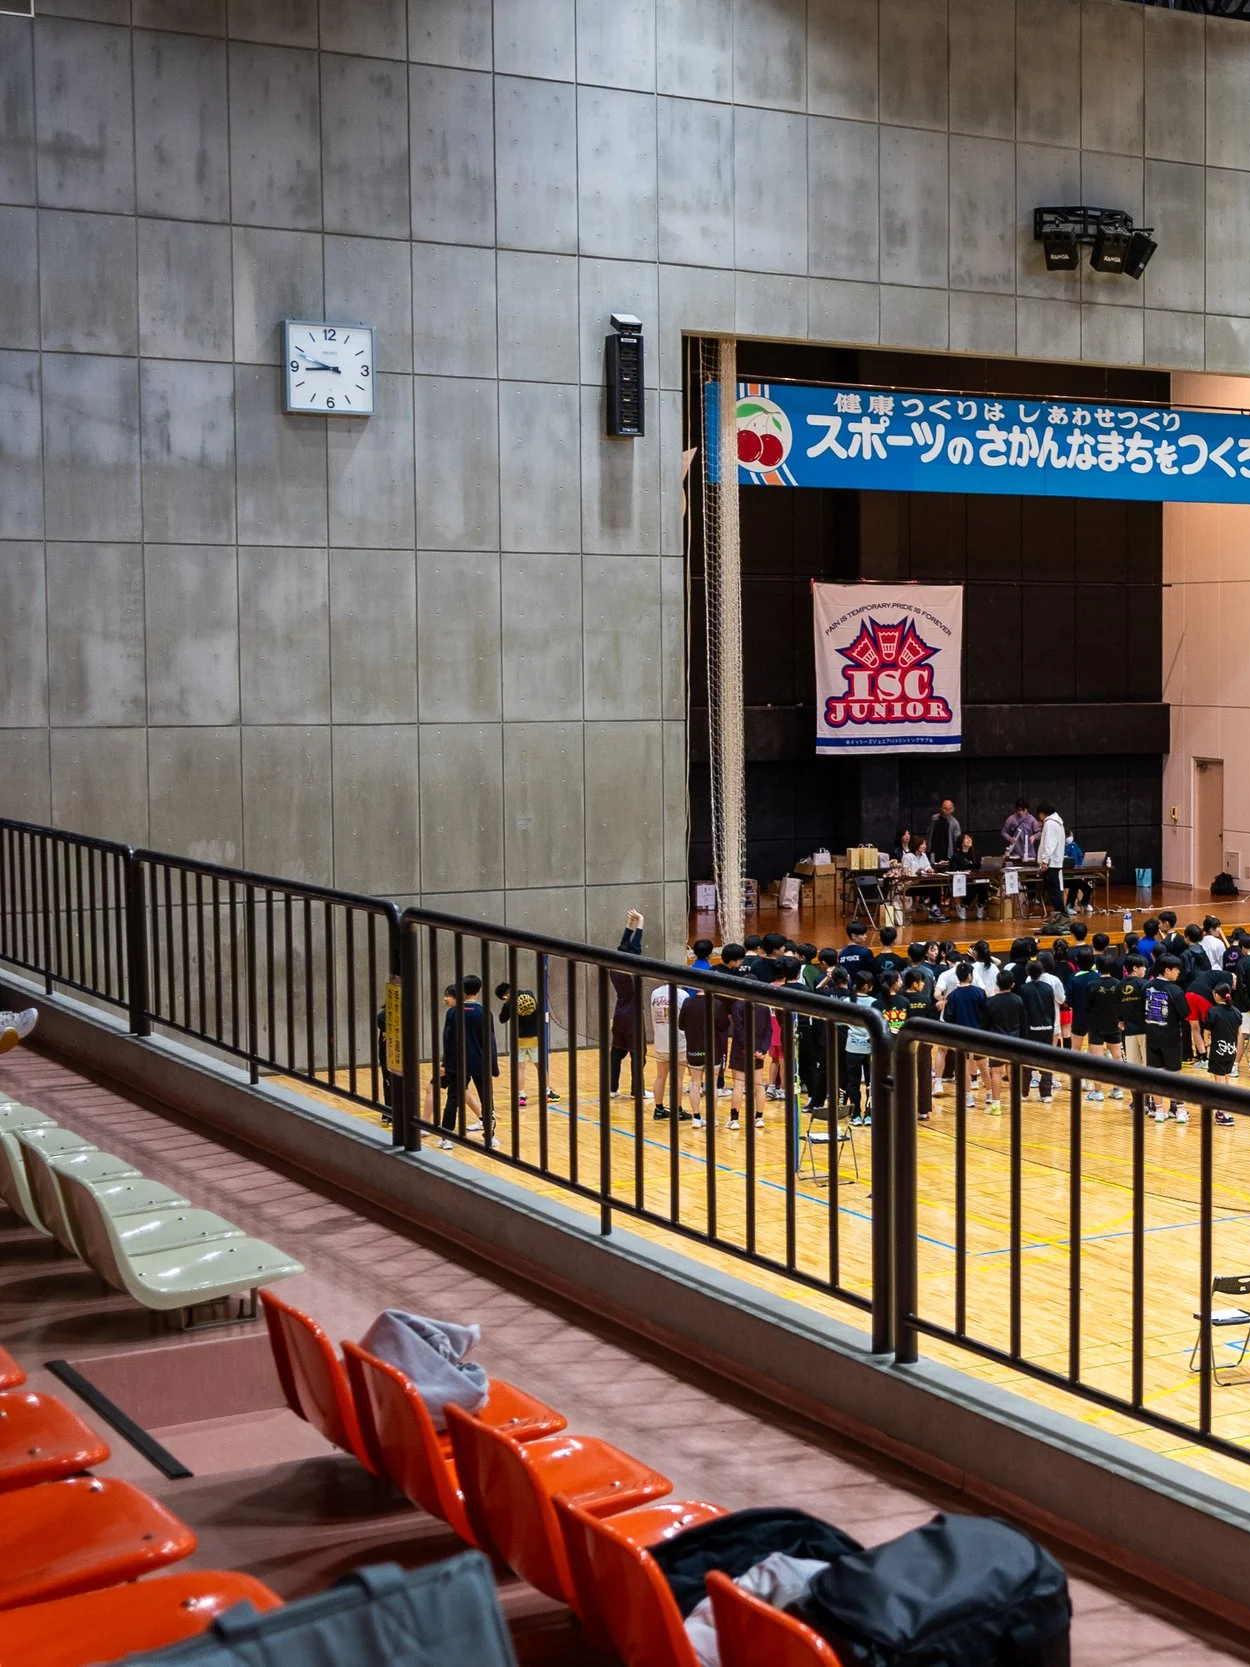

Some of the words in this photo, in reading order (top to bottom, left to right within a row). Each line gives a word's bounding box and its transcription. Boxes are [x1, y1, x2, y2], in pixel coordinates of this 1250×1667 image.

[322, 328, 337, 341] 12
[290, 360, 300, 373] 9
[360, 364, 370, 377] 3
[326, 396, 336, 409] 6
[1018, 403, 1181, 432] しあわせつくり
[825, 620, 841, 636] PAIN
[840, 615, 848, 623] IS
[913, 606, 922, 614] IS
[921, 610, 952, 636] FOREVER
[848, 669, 929, 701] ISC
[831, 701, 948, 722] JUNIOR
